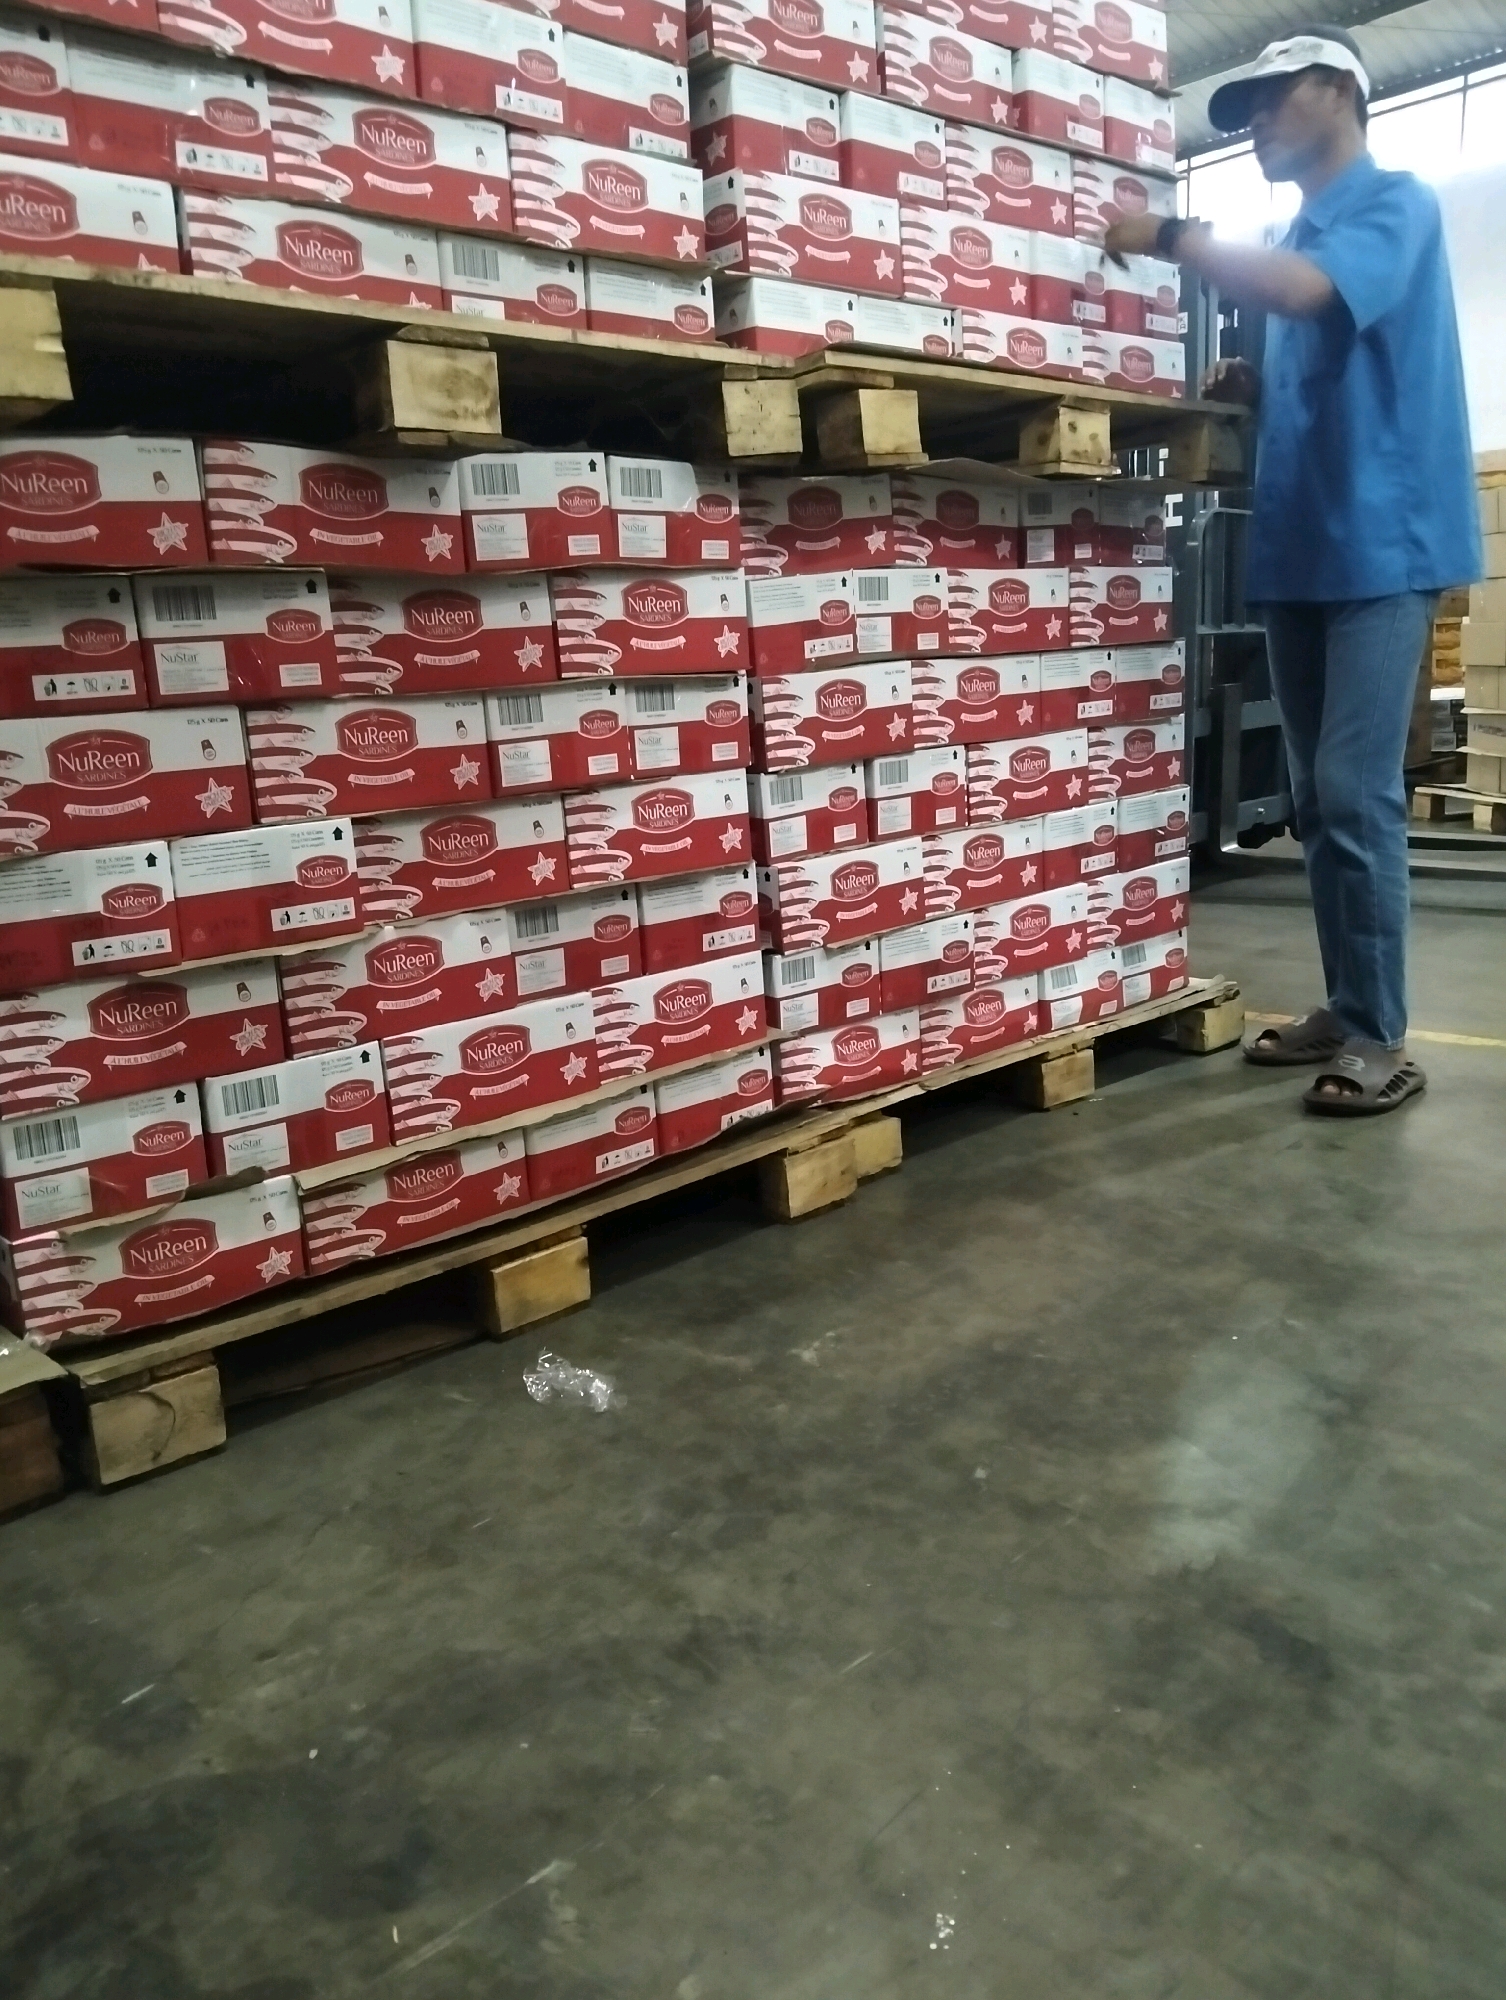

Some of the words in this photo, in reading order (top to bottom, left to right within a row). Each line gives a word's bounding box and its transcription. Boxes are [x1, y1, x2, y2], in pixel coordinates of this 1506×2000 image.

[773, 2, 818, 24] NuReen
[932, 48, 970, 72] NuReen
[209, 106, 254, 126] NuReen
[361, 123, 427, 155] NuReen
[588, 171, 641, 201] NuReen
[0, 193, 67, 223] uReen
[803, 208, 848, 227] NuReen
[284, 236, 353, 265] NuReen
[952, 239, 989, 257] NuReen
[1, 473, 88, 494] NuReen
[308, 481, 378, 503] NuReen
[477, 523, 506, 533] NuStar
[628, 597, 681, 614] NuReen
[411, 608, 475, 625] NuReen
[272, 621, 316, 633] NuReen
[70, 631, 120, 644] NuReen
[160, 653, 199, 666] NuStar
[960, 679, 996, 693] NuReen
[820, 694, 862, 708] NuReen
[345, 728, 408, 746] NuReen
[57, 751, 141, 773] NuReen
[638, 804, 688, 822] NuReen
[428, 832, 489, 851] NuReen
[301, 864, 343, 880] NuReen
[834, 874, 874, 888] NuReen
[108, 895, 157, 910] NuReen
[374, 952, 435, 974] NuReen
[659, 994, 706, 1015] NuReen
[966, 1000, 1002, 1016] NuReen
[99, 1001, 178, 1027] NuReen
[467, 1040, 524, 1062] NuReen
[836, 1037, 876, 1054] NuReen
[330, 1088, 370, 1104] NuReen
[139, 1130, 185, 1145] NuReen
[228, 1139, 262, 1151] NuStar
[392, 1164, 455, 1190] NuReen
[22, 1184, 60, 1198] NuStar
[130, 1235, 207, 1266] NuReen
